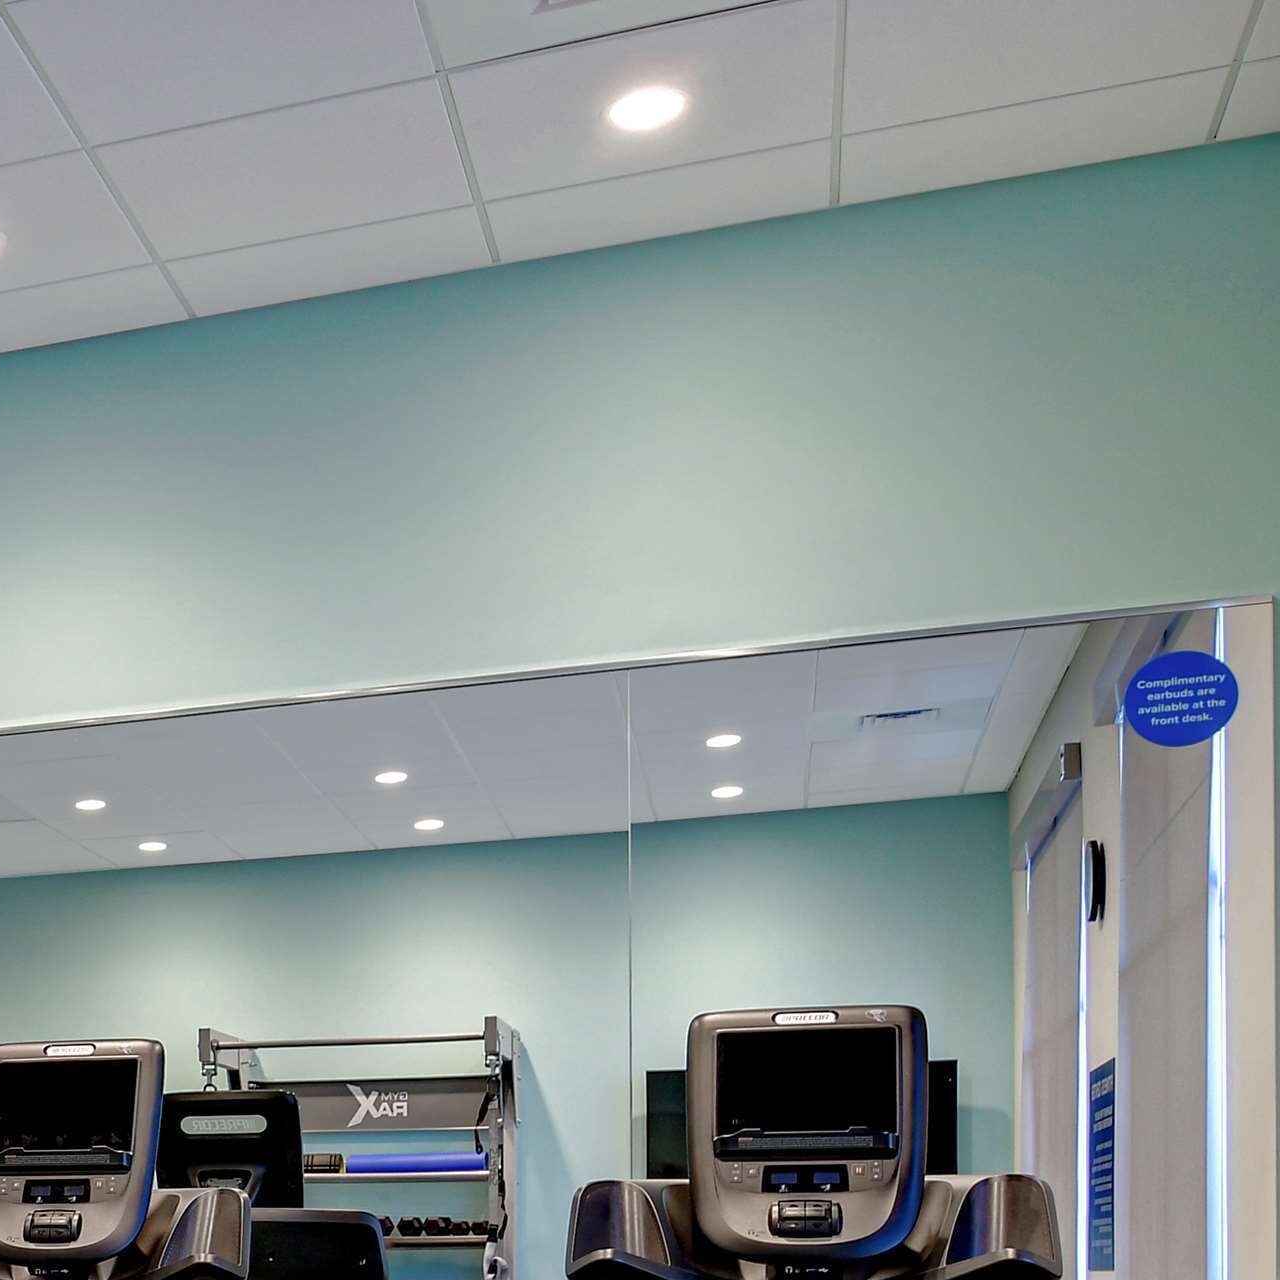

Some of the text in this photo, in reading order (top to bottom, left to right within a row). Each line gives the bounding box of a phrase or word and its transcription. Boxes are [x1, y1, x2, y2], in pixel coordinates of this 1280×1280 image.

[1137, 674, 1226, 689] Complimentary
[1147, 687, 1216, 701] earbuds are
[1138, 698, 1226, 715] available at the
[1151, 713, 1213, 726] front desk.
